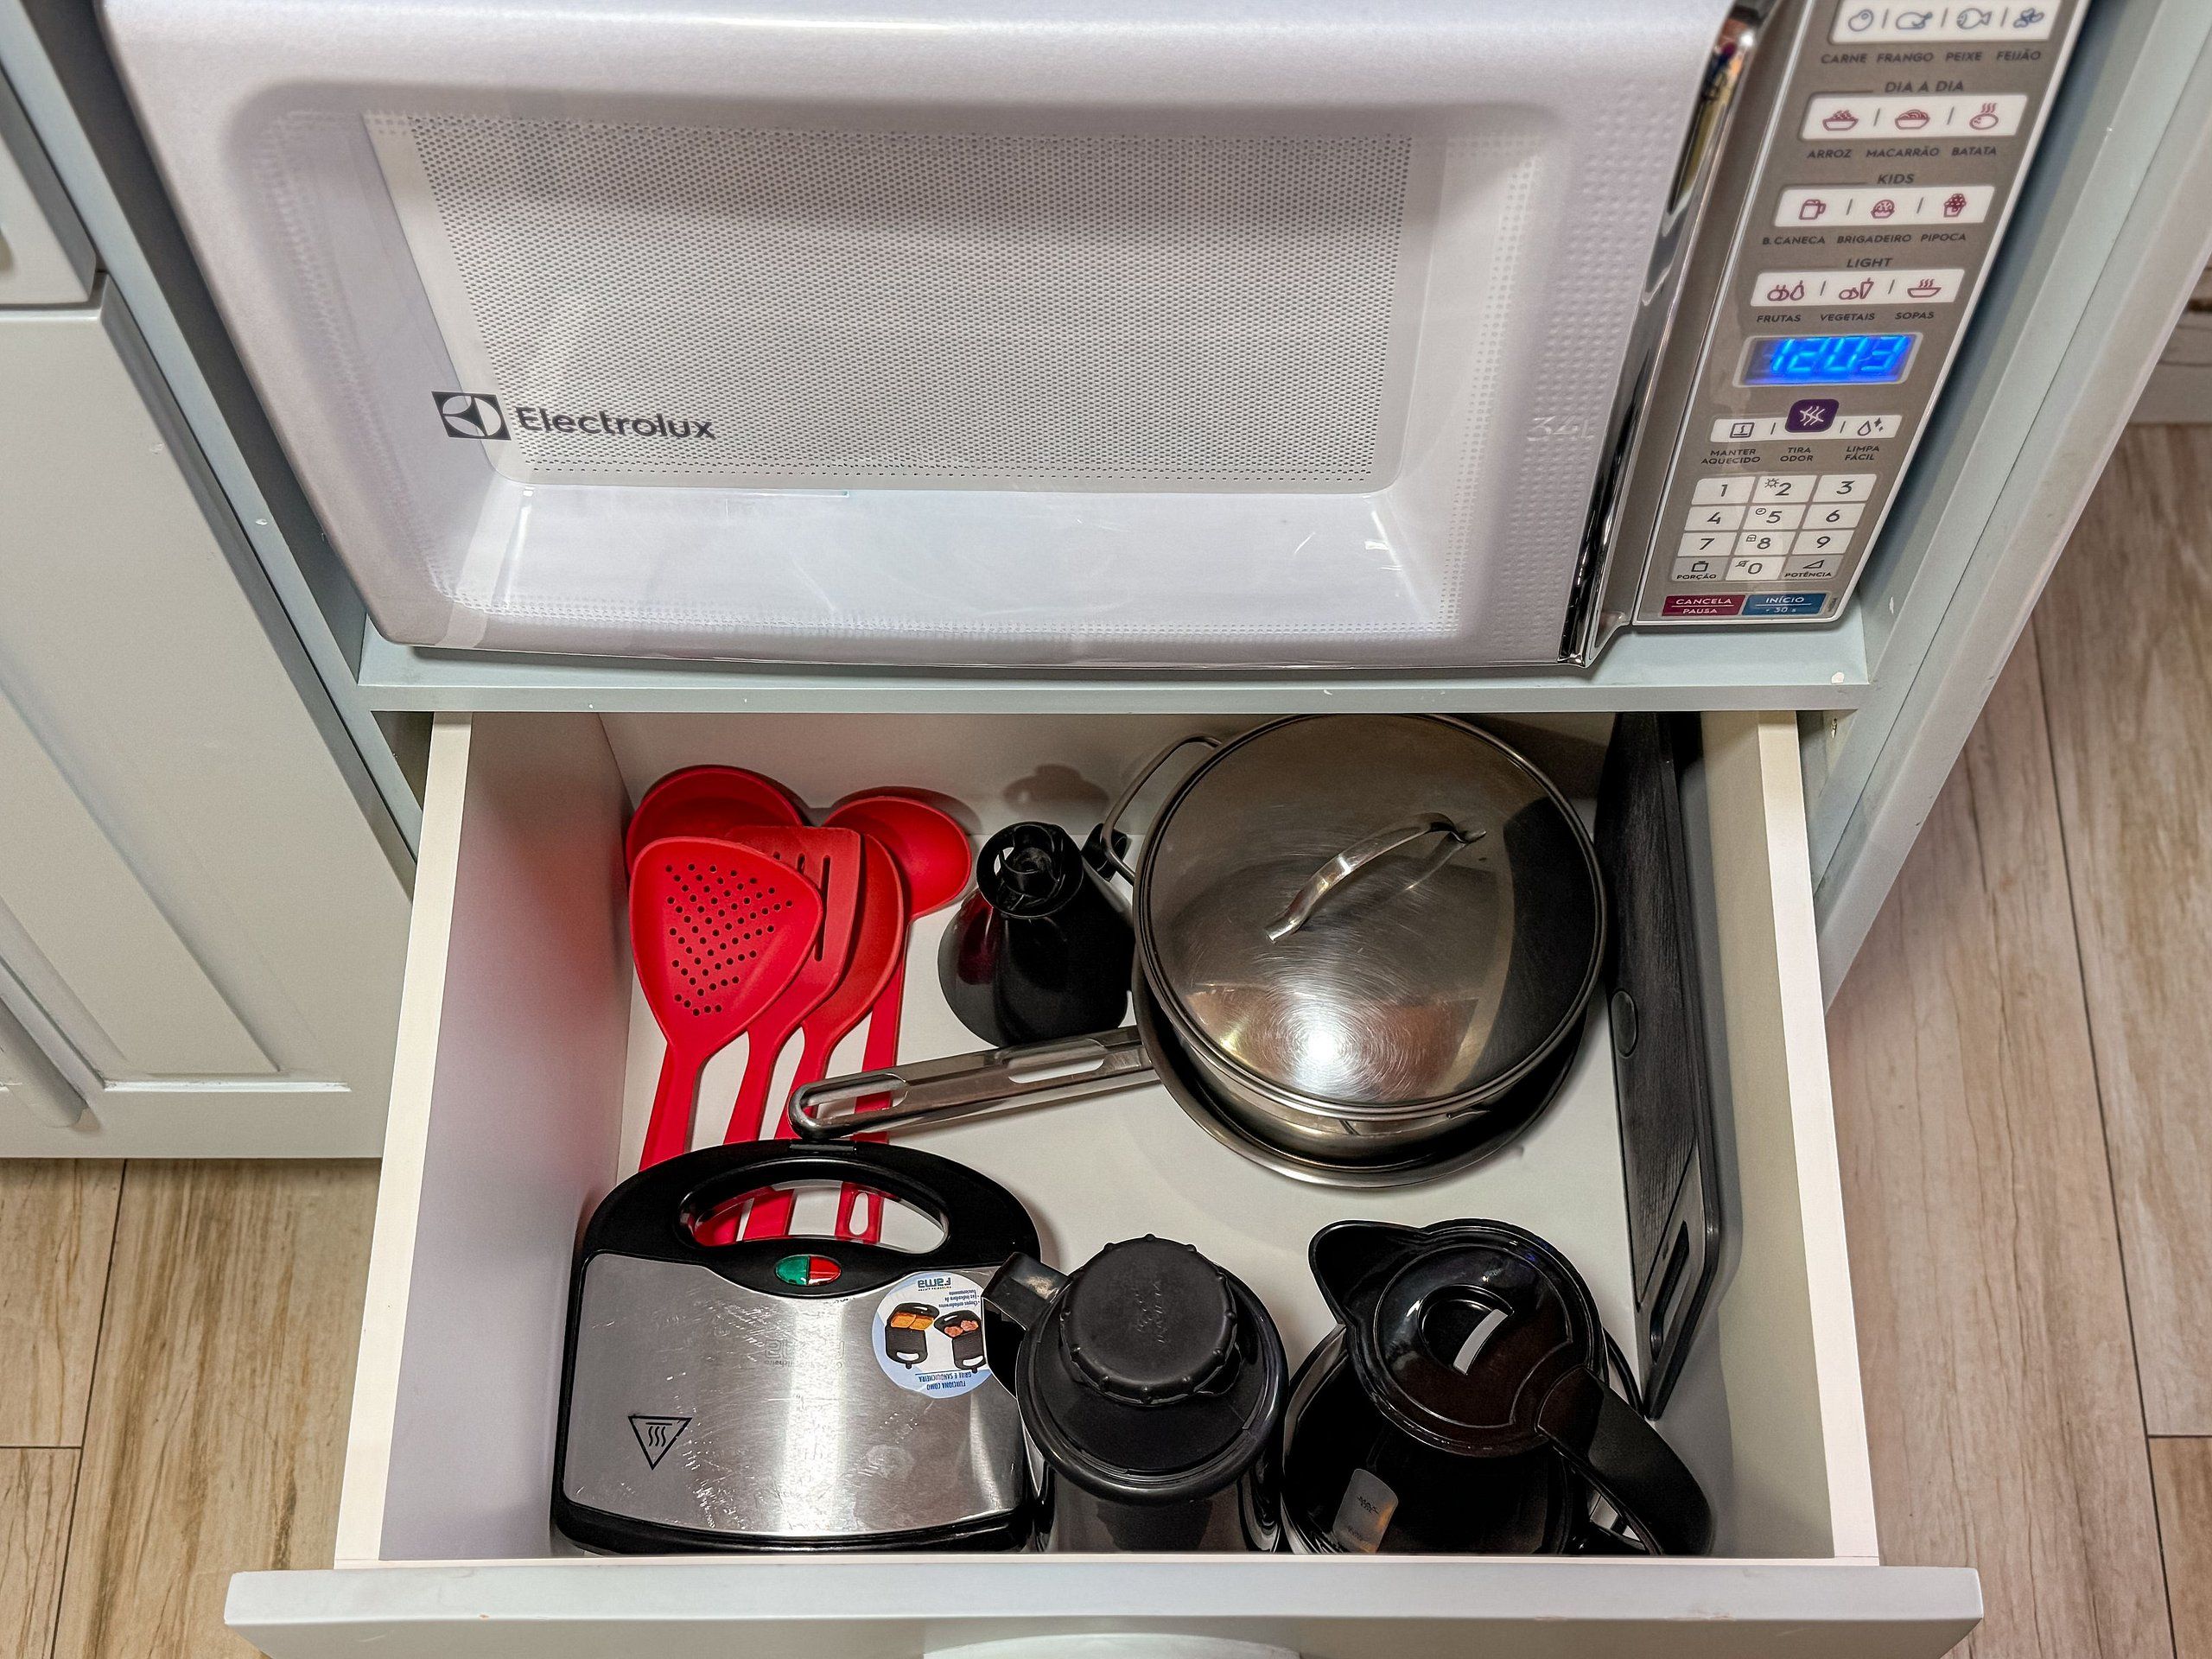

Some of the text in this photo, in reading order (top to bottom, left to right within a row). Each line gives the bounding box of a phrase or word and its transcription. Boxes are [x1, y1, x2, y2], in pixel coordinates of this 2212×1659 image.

[1820, 53, 1867, 65] CARNE
[1876, 52, 1935, 64] FRANGO
[1945, 51, 1983, 62] PEIXE
[1996, 49, 2042, 61] FEIJÃO
[1884, 80, 1965, 93] DIA A DIA
[1806, 148, 1853, 159] ARROZ
[1866, 145, 1941, 157] MACARRÃO
[1951, 145, 1998, 156] BATATA
[1876, 173, 1916, 185] KIDS
[1836, 234, 1912, 245] BRIGADEIRO
[1920, 232, 1967, 243] PIPOCA
[1846, 257, 1894, 269] LIGHT
[1756, 314, 1802, 323] FRUTAS
[1820, 312, 1875, 322] VEGETAIS
[1894, 311, 1935, 321] SOPAS
[516, 406, 716, 441] Electrolux
[1710, 448, 1757, 457] MANTER
[1846, 444, 1880, 454] LIMPA
[1700, 455, 1761, 465] AQUECIDO
[1780, 454, 1814, 462] ODOR
[1844, 452, 1875, 461] FÁCIL
[1719, 483, 1728, 498] 1
[1775, 481, 1793, 497] 2
[1835, 480, 1856, 495] 3
[1707, 512, 1722, 524] 4
[1765, 510, 1783, 524] 5
[1825, 509, 1840, 523] 6
[1699, 537, 1715, 551] 7
[1756, 536, 1771, 550] 8
[1816, 536, 1832, 550] 9
[1746, 562, 1763, 575] 0
[1783, 570, 1832, 579] POTÊNCIA
[1765, 595, 1804, 604] INÍCIO
[941, 1380, 966, 1389] FUNCIONA
